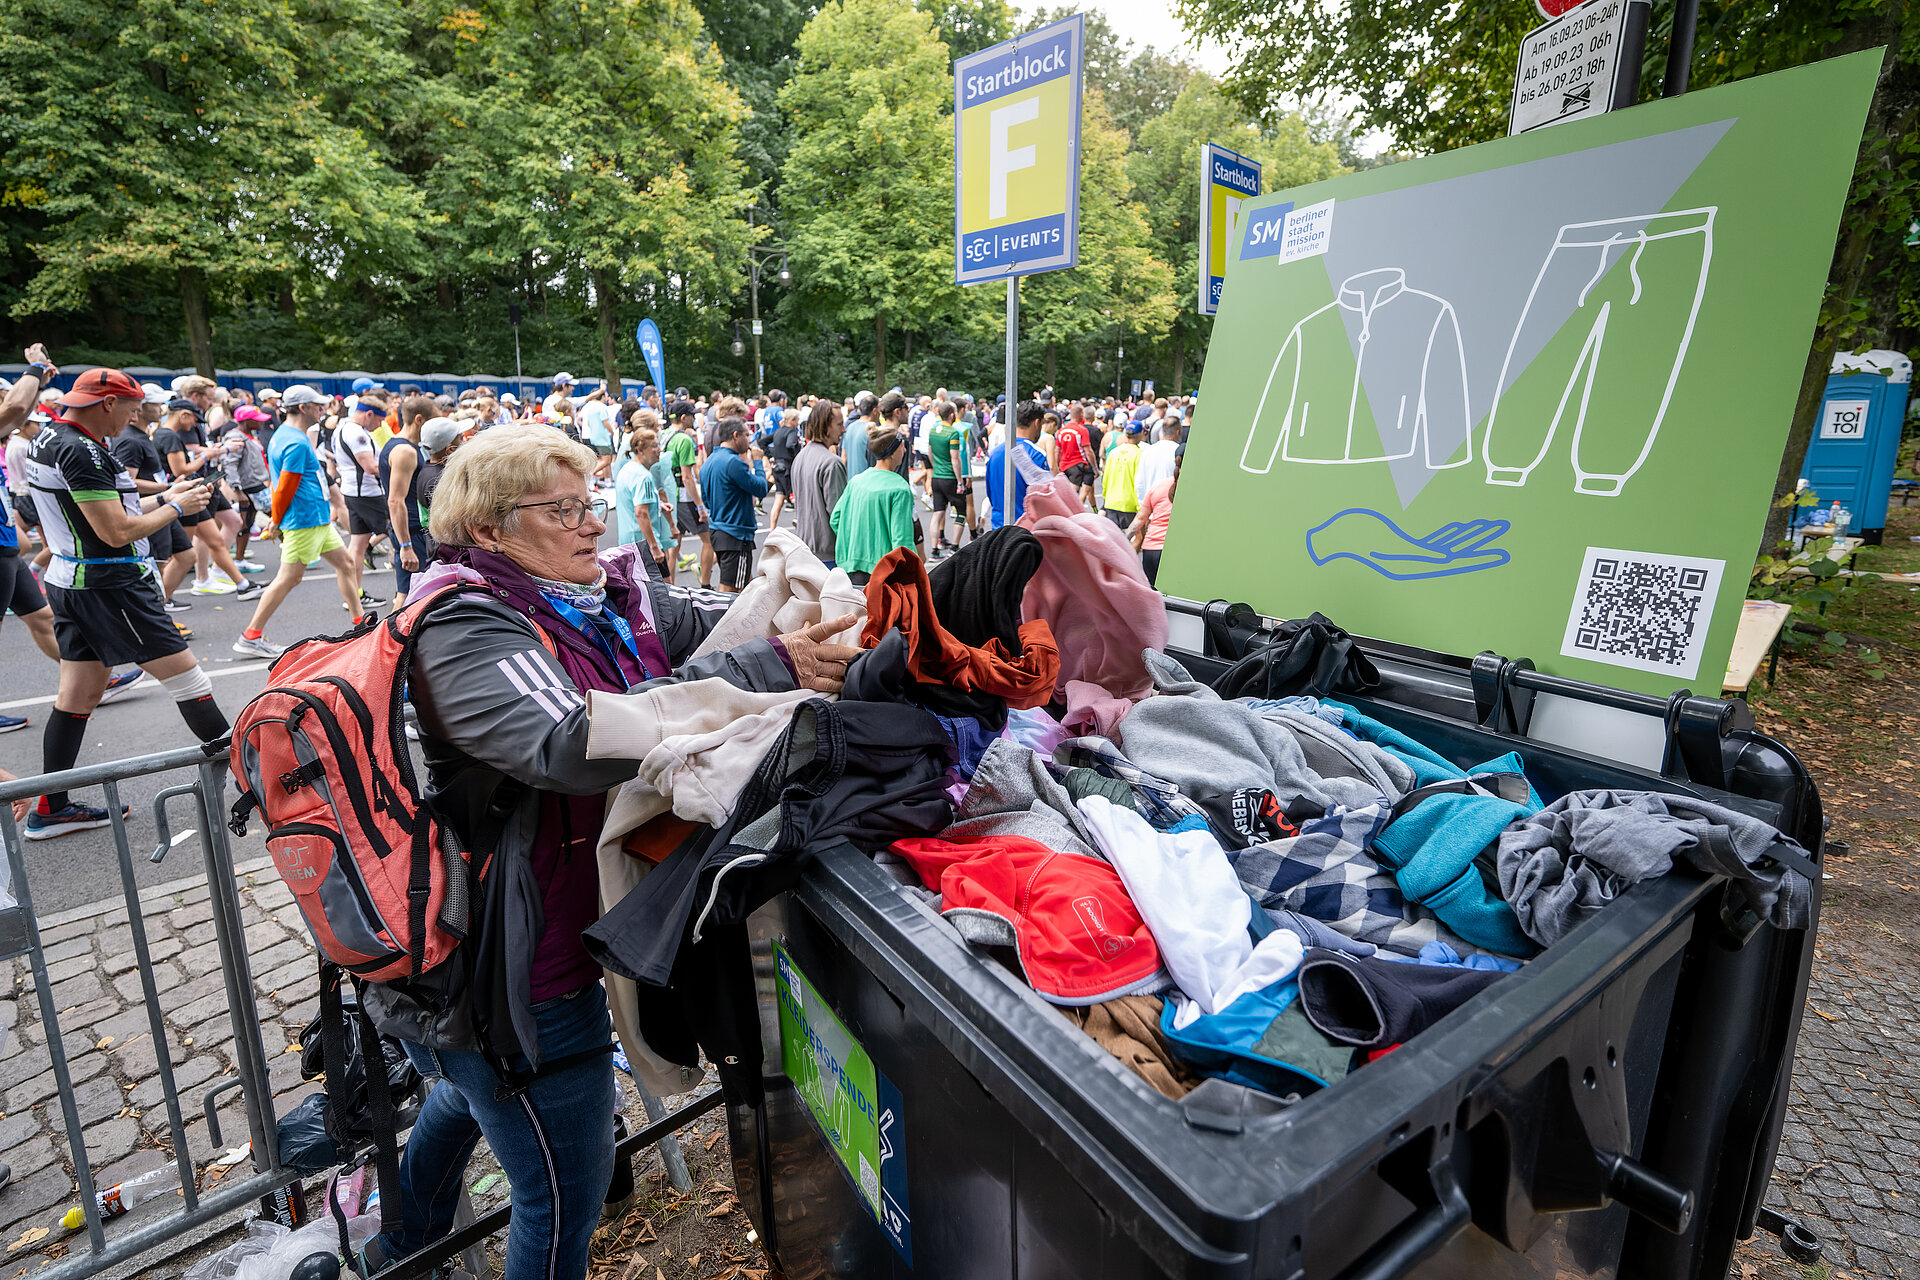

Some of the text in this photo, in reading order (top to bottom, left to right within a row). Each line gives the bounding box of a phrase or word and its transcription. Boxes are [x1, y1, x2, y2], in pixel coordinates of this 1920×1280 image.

[1531, 2, 1619, 57] Am 16.09.23 06-24h
[1523, 30, 1612, 83] Ab 19.09.23 06h
[966, 44, 1066, 100] Startblock
[1520, 56, 1605, 105] bis 26.09.23 18h
[989, 96, 1040, 220] F
[1214, 161, 1257, 192] Startblock
[1287, 222, 1314, 238] stadt
[1289, 208, 1329, 227] berliner
[1002, 227, 1060, 253] EVENTS
[1249, 217, 1282, 246] SM
[1286, 231, 1325, 249] mission
[1296, 242, 1320, 254] kirche
[1833, 423, 1858, 433] TOI
[1835, 411, 1860, 422] TOI
[1086, 906, 1104, 932] LONDON
[781, 986, 876, 1127] KLEIDERSPENDE
